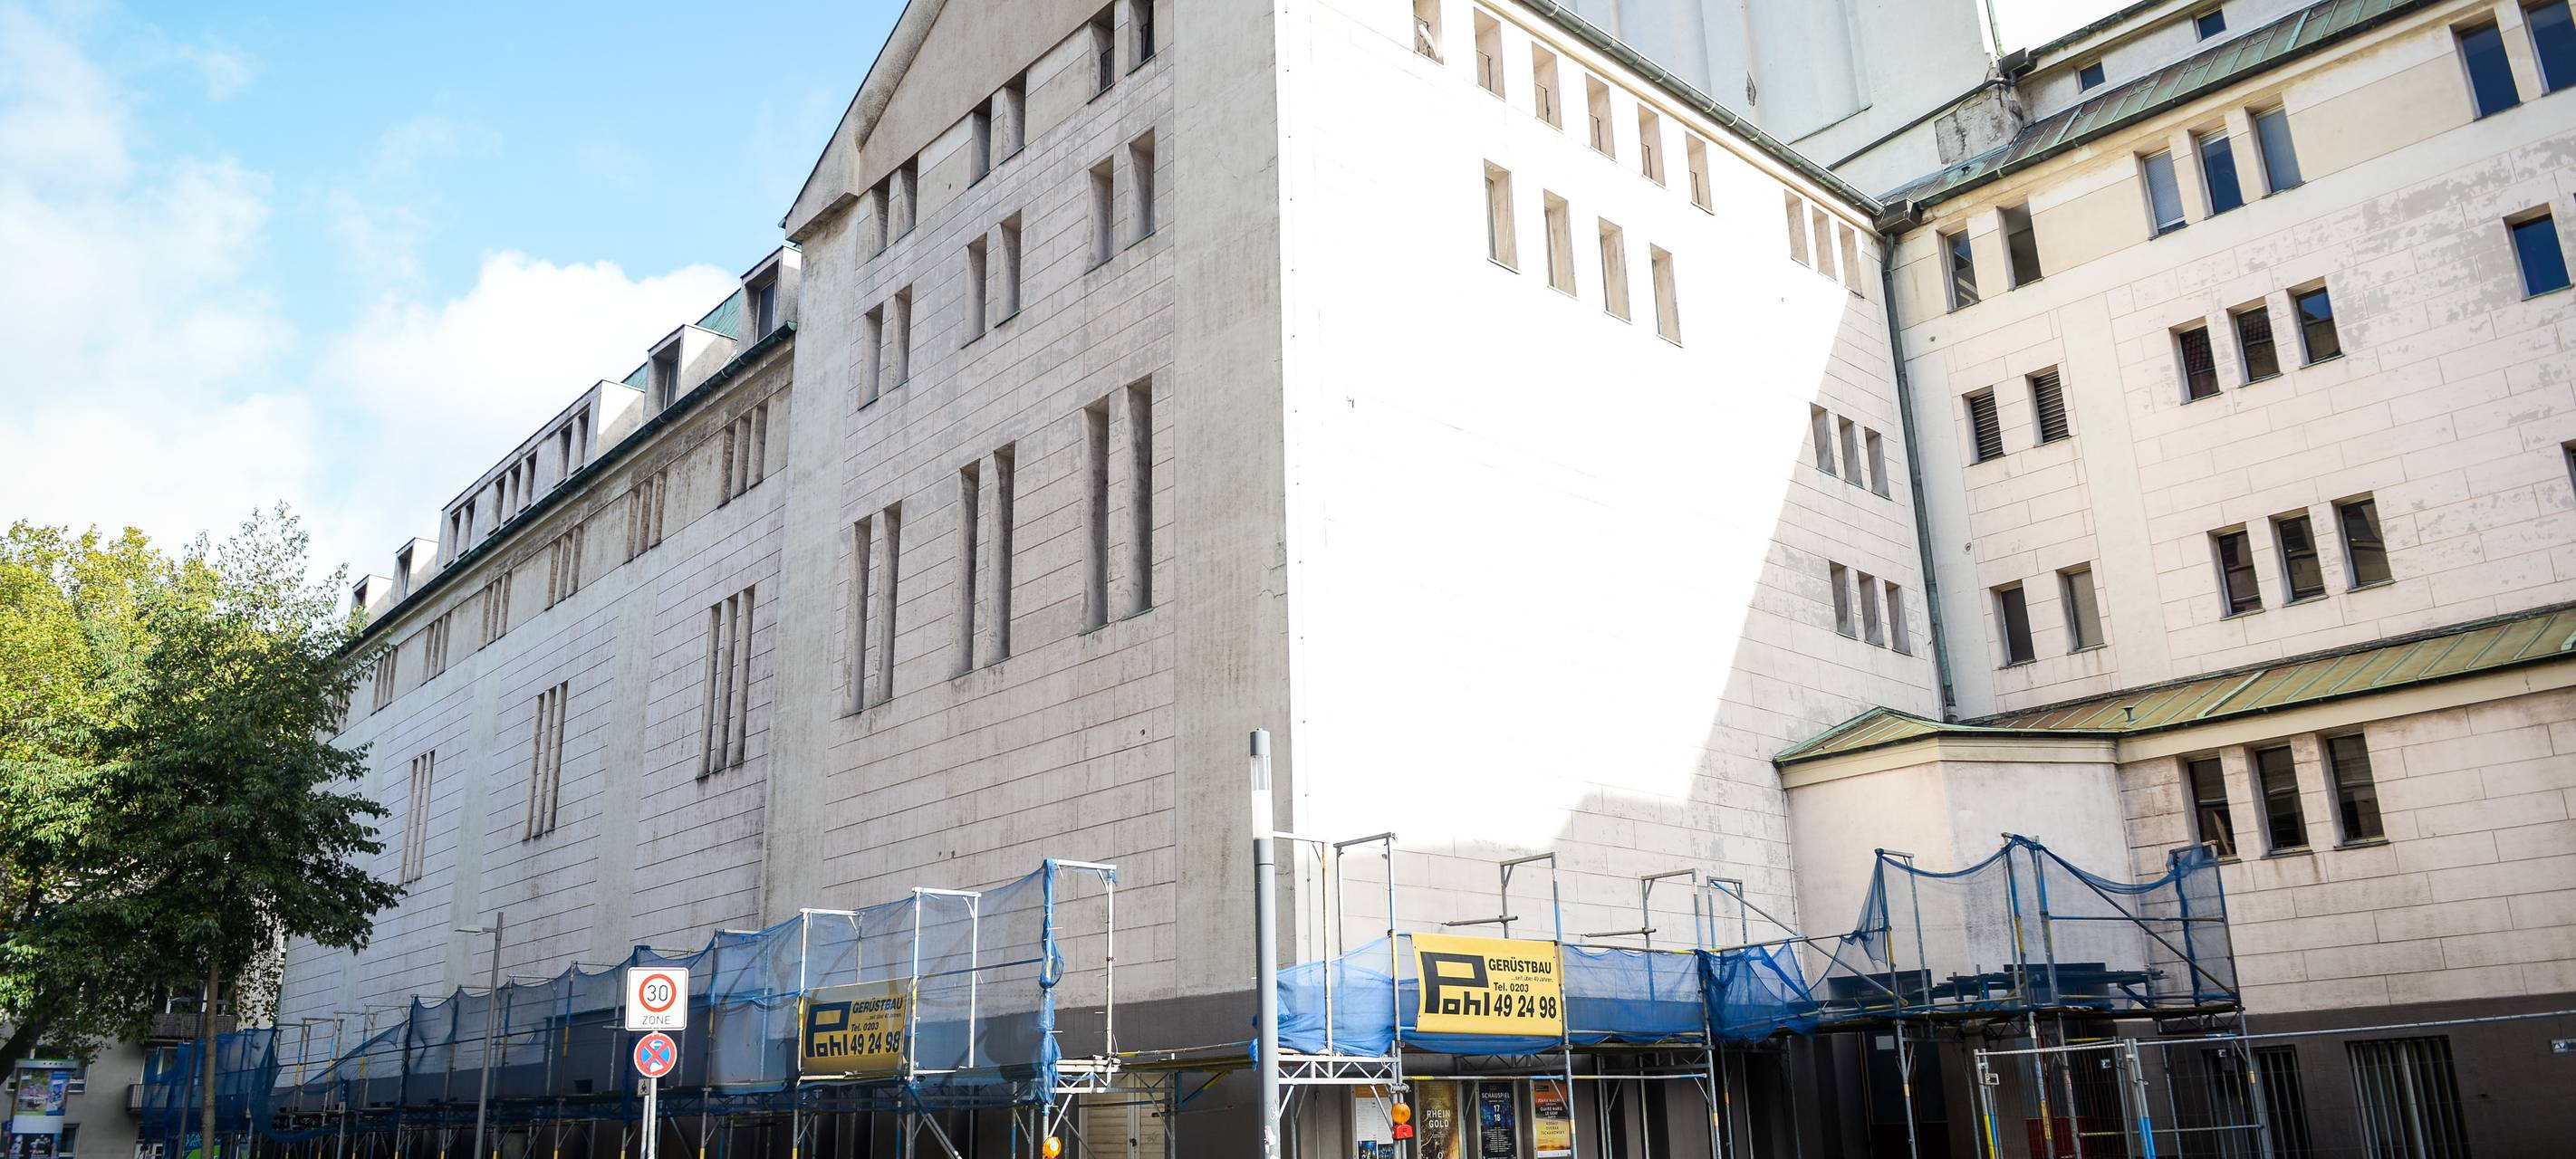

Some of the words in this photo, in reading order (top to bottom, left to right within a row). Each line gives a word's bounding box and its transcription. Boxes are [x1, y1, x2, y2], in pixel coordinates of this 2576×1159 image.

[1488, 957, 1552, 974] GERÜSTBAU
[1419, 952, 1490, 1016] Pohl
[1494, 982, 1508, 991] Tel.
[1510, 983, 1529, 992] 0203
[647, 984, 668, 1001] 30
[852, 997, 903, 1013] GERÜSTBAU
[1494, 994, 1513, 1017] 49
[1517, 994, 1535, 1018] 24
[1539, 995, 1557, 1019] 98
[642, 1015, 671, 1025] ZONE
[863, 1022, 879, 1031] 0203
[851, 1034, 864, 1055] 49
[868, 1032, 882, 1054] 24
[886, 1030, 900, 1053] 98
[1427, 1109, 1450, 1118] RHEIN
[1494, 1104, 1500, 1113] 17
[1494, 1114, 1501, 1122] 18
[1428, 1119, 1449, 1128] GOLD
